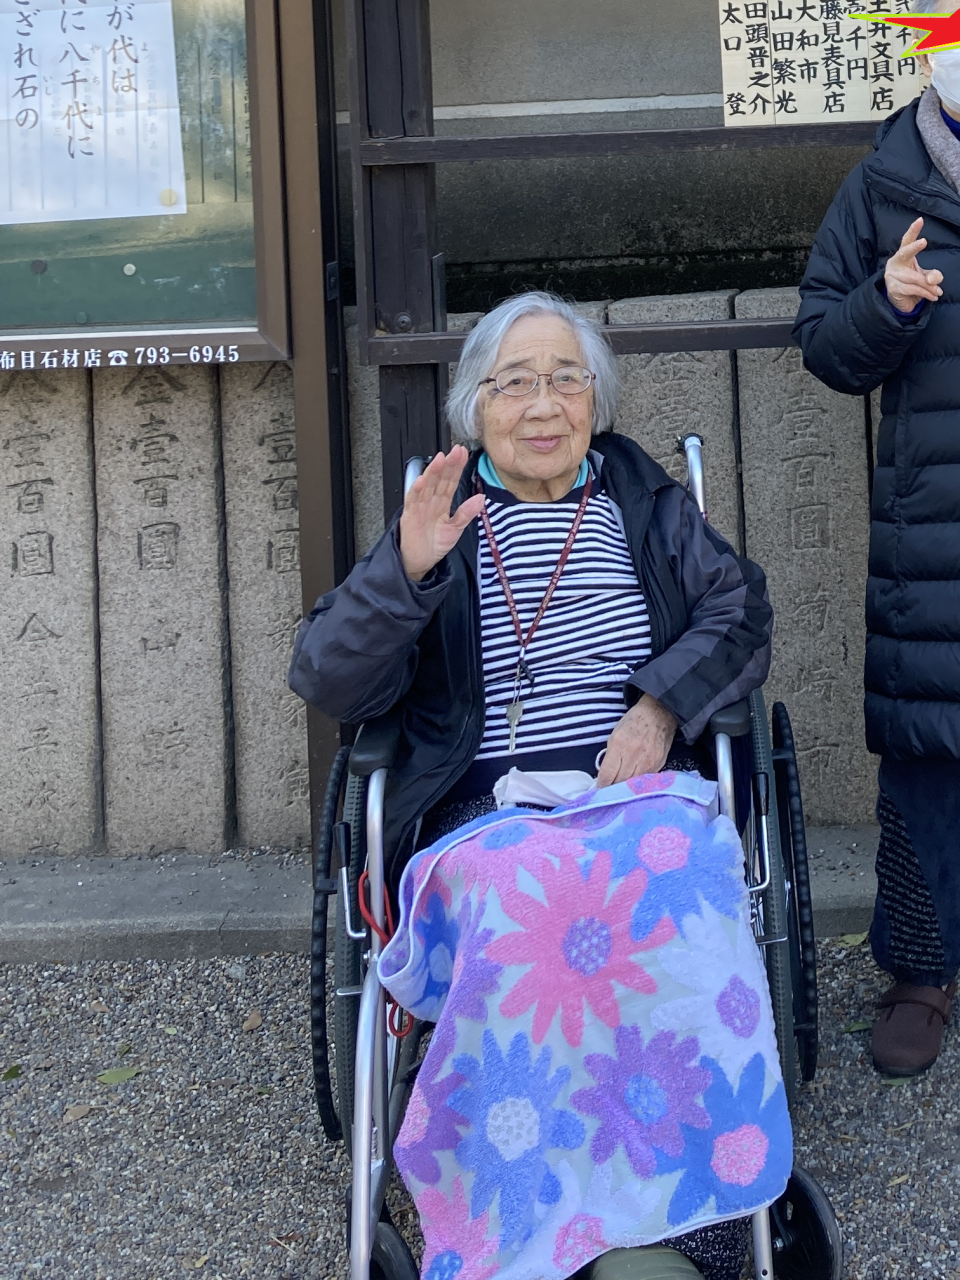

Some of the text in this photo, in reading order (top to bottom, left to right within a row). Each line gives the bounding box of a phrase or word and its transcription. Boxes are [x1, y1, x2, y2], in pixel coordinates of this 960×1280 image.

[744, 2, 772, 115] 田頭晋之介
[771, 0, 797, 114] 山田繁光
[134, 345, 240, 365] 793-6945
